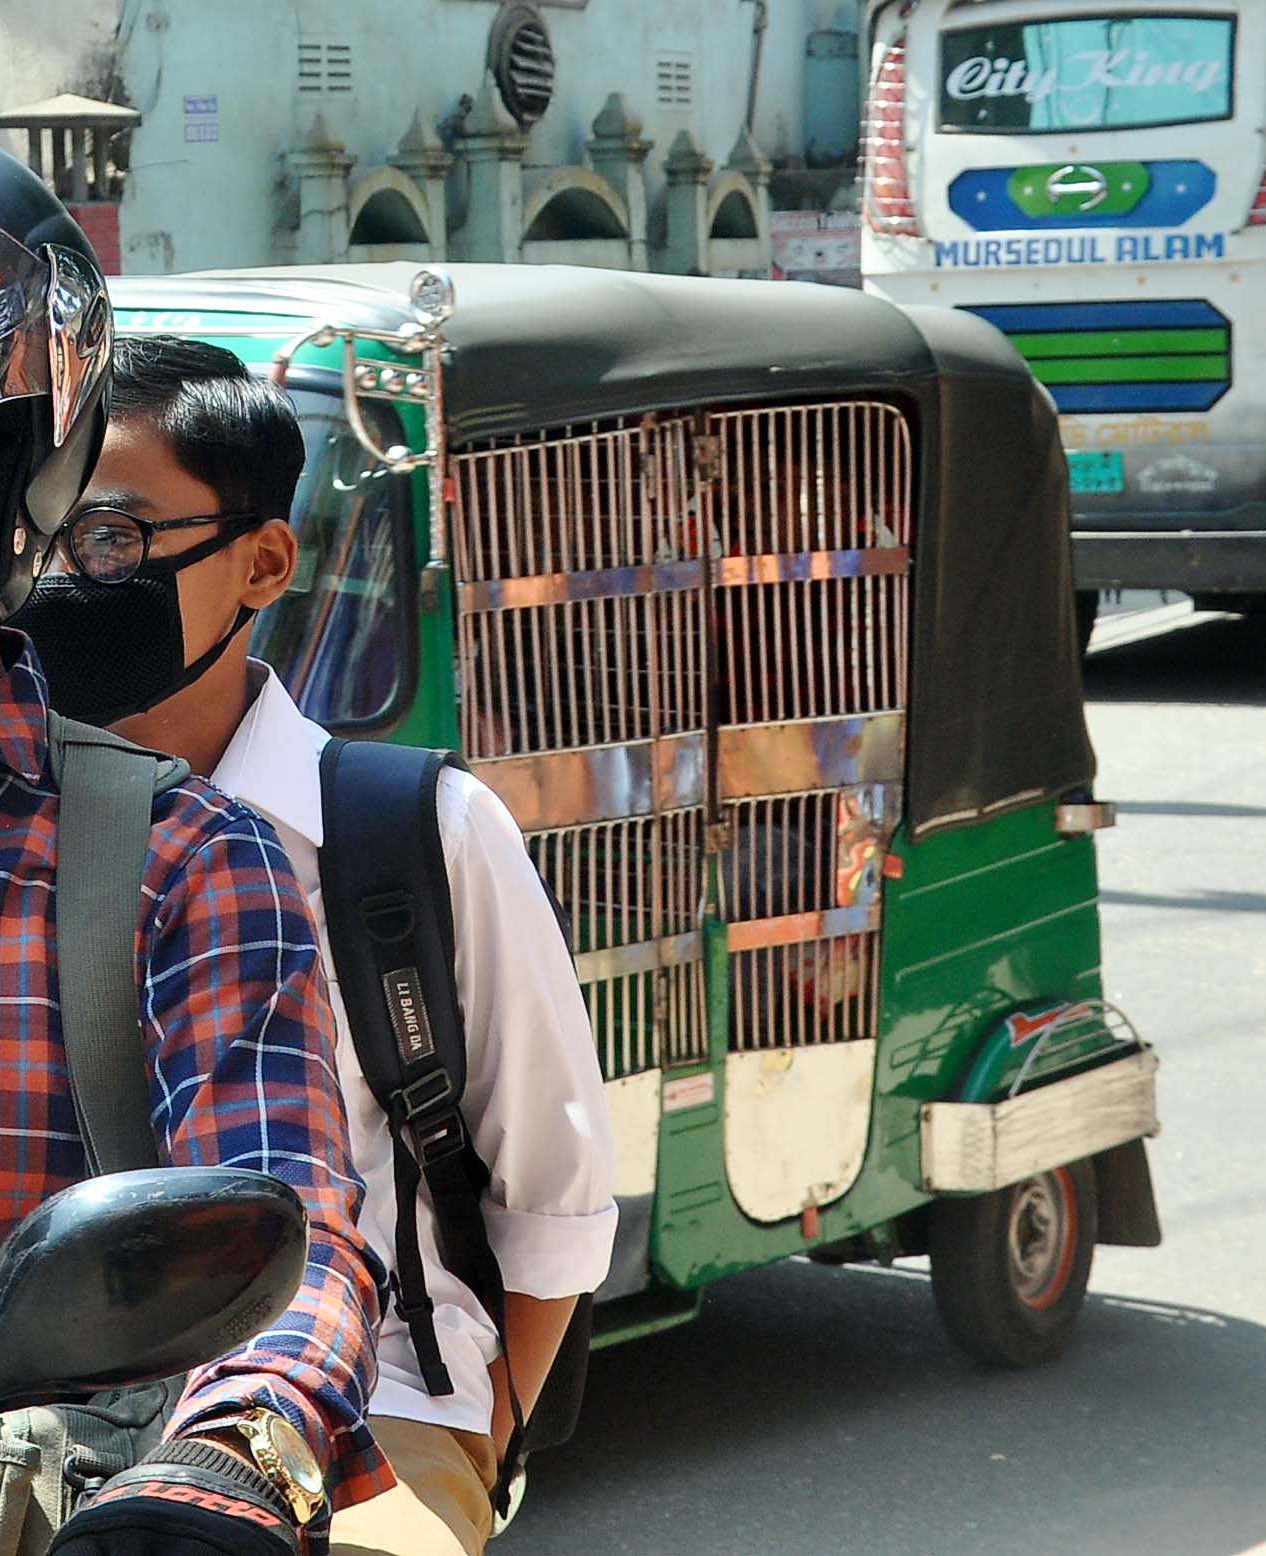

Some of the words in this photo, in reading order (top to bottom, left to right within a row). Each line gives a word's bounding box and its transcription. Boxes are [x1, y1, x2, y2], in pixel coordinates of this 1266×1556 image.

[946, 56, 1057, 102] City
[1060, 48, 1224, 92] King
[935, 237, 1105, 267] MURSEDUL
[1117, 233, 1226, 263] ALAM
[400, 998, 420, 1033] BANG
